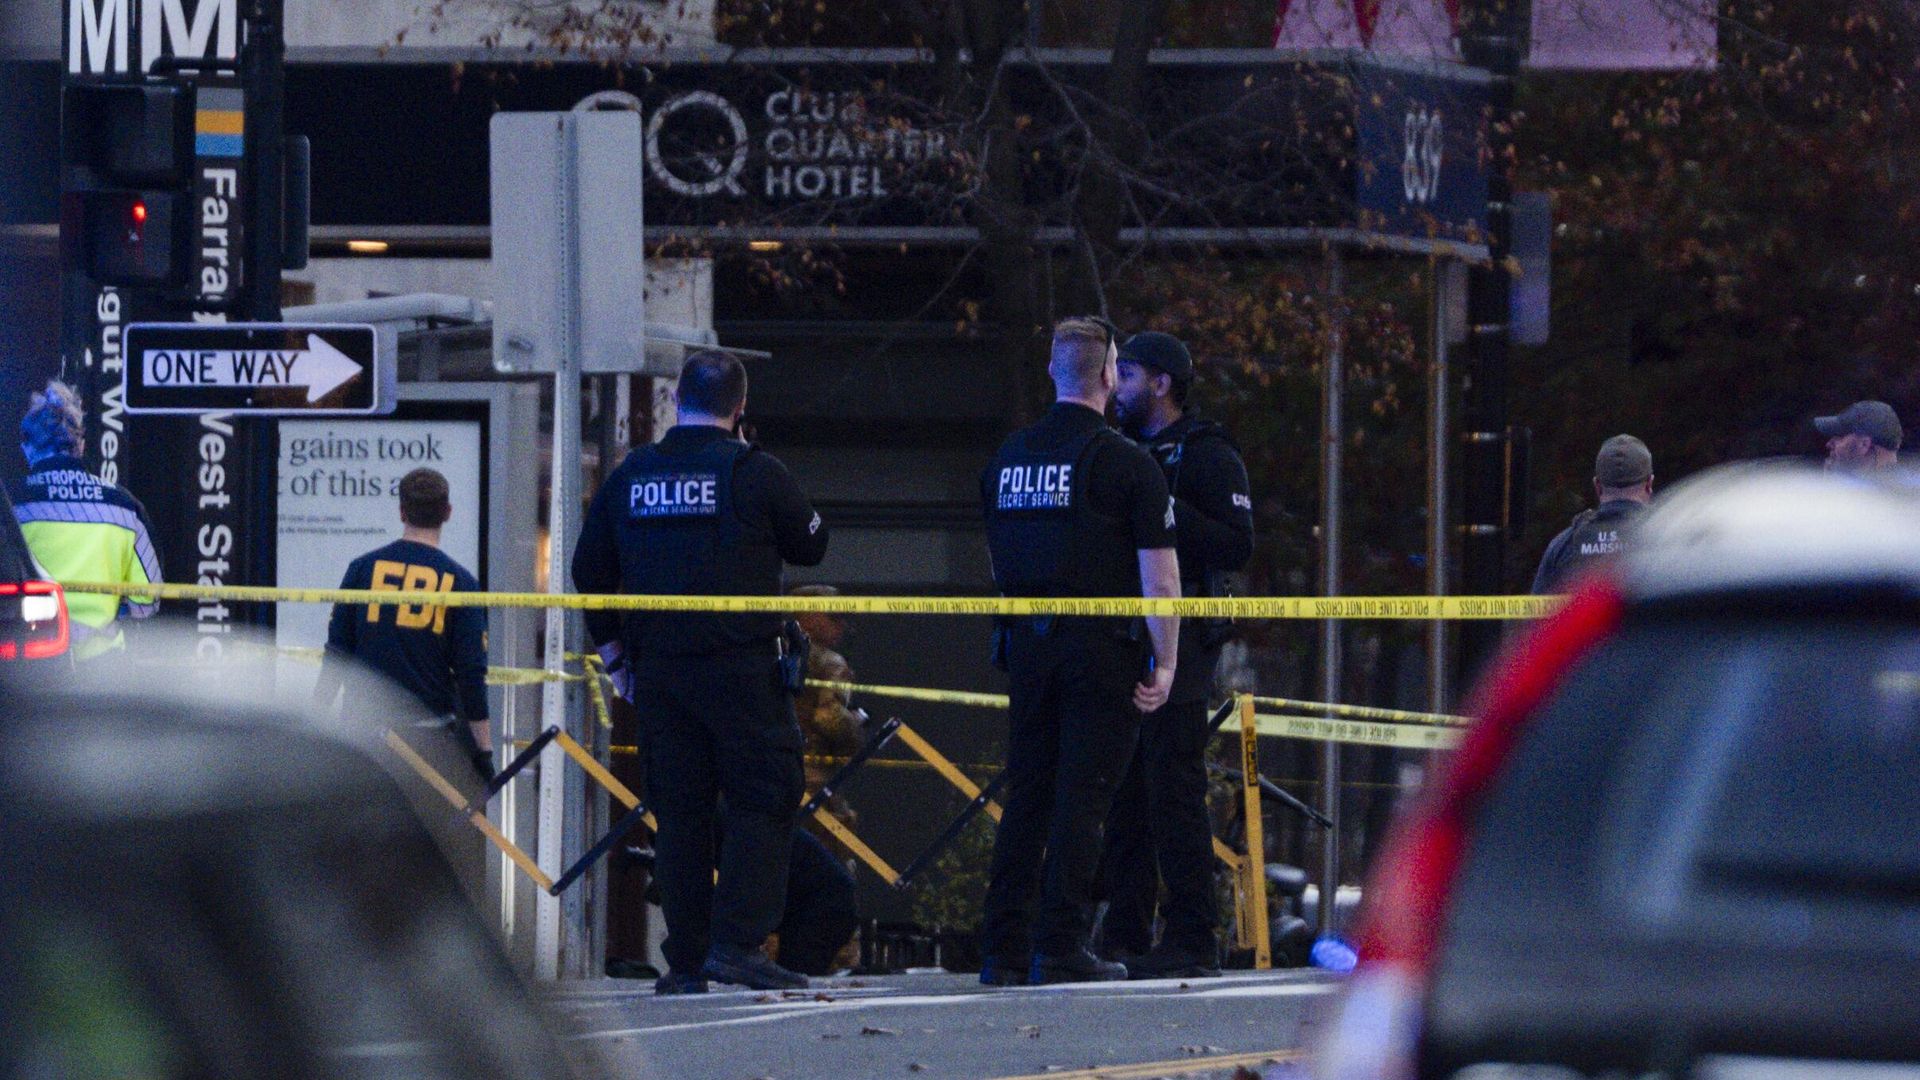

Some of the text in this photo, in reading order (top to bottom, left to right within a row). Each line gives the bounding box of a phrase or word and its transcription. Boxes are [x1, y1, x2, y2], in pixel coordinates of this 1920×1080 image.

[766, 165, 888, 198] HOTEL
[152, 352, 300, 384] ONE WAY
[289, 431, 370, 467] gains
[377, 433, 442, 461] took
[290, 470, 324, 496] of
[328, 470, 387, 497] this
[998, 465, 1072, 494] POLICE
[48, 485, 104, 500] POLICE
[630, 480, 717, 508] POLICE
[998, 492, 1070, 508] SECRET SERVICE
[367, 560, 455, 635] FBI
[1029, 600, 1143, 616] POLICE LINE DO NOT CROSS
[1172, 600, 1286, 616] POLICE LINE DO NOT CROSS
[1315, 600, 1429, 616] POLICE LINE DO NOT CROSS
[1459, 600, 1488, 616] CROSS
[1490, 600, 1506, 616] NOT
[1508, 600, 1522, 616] DO
